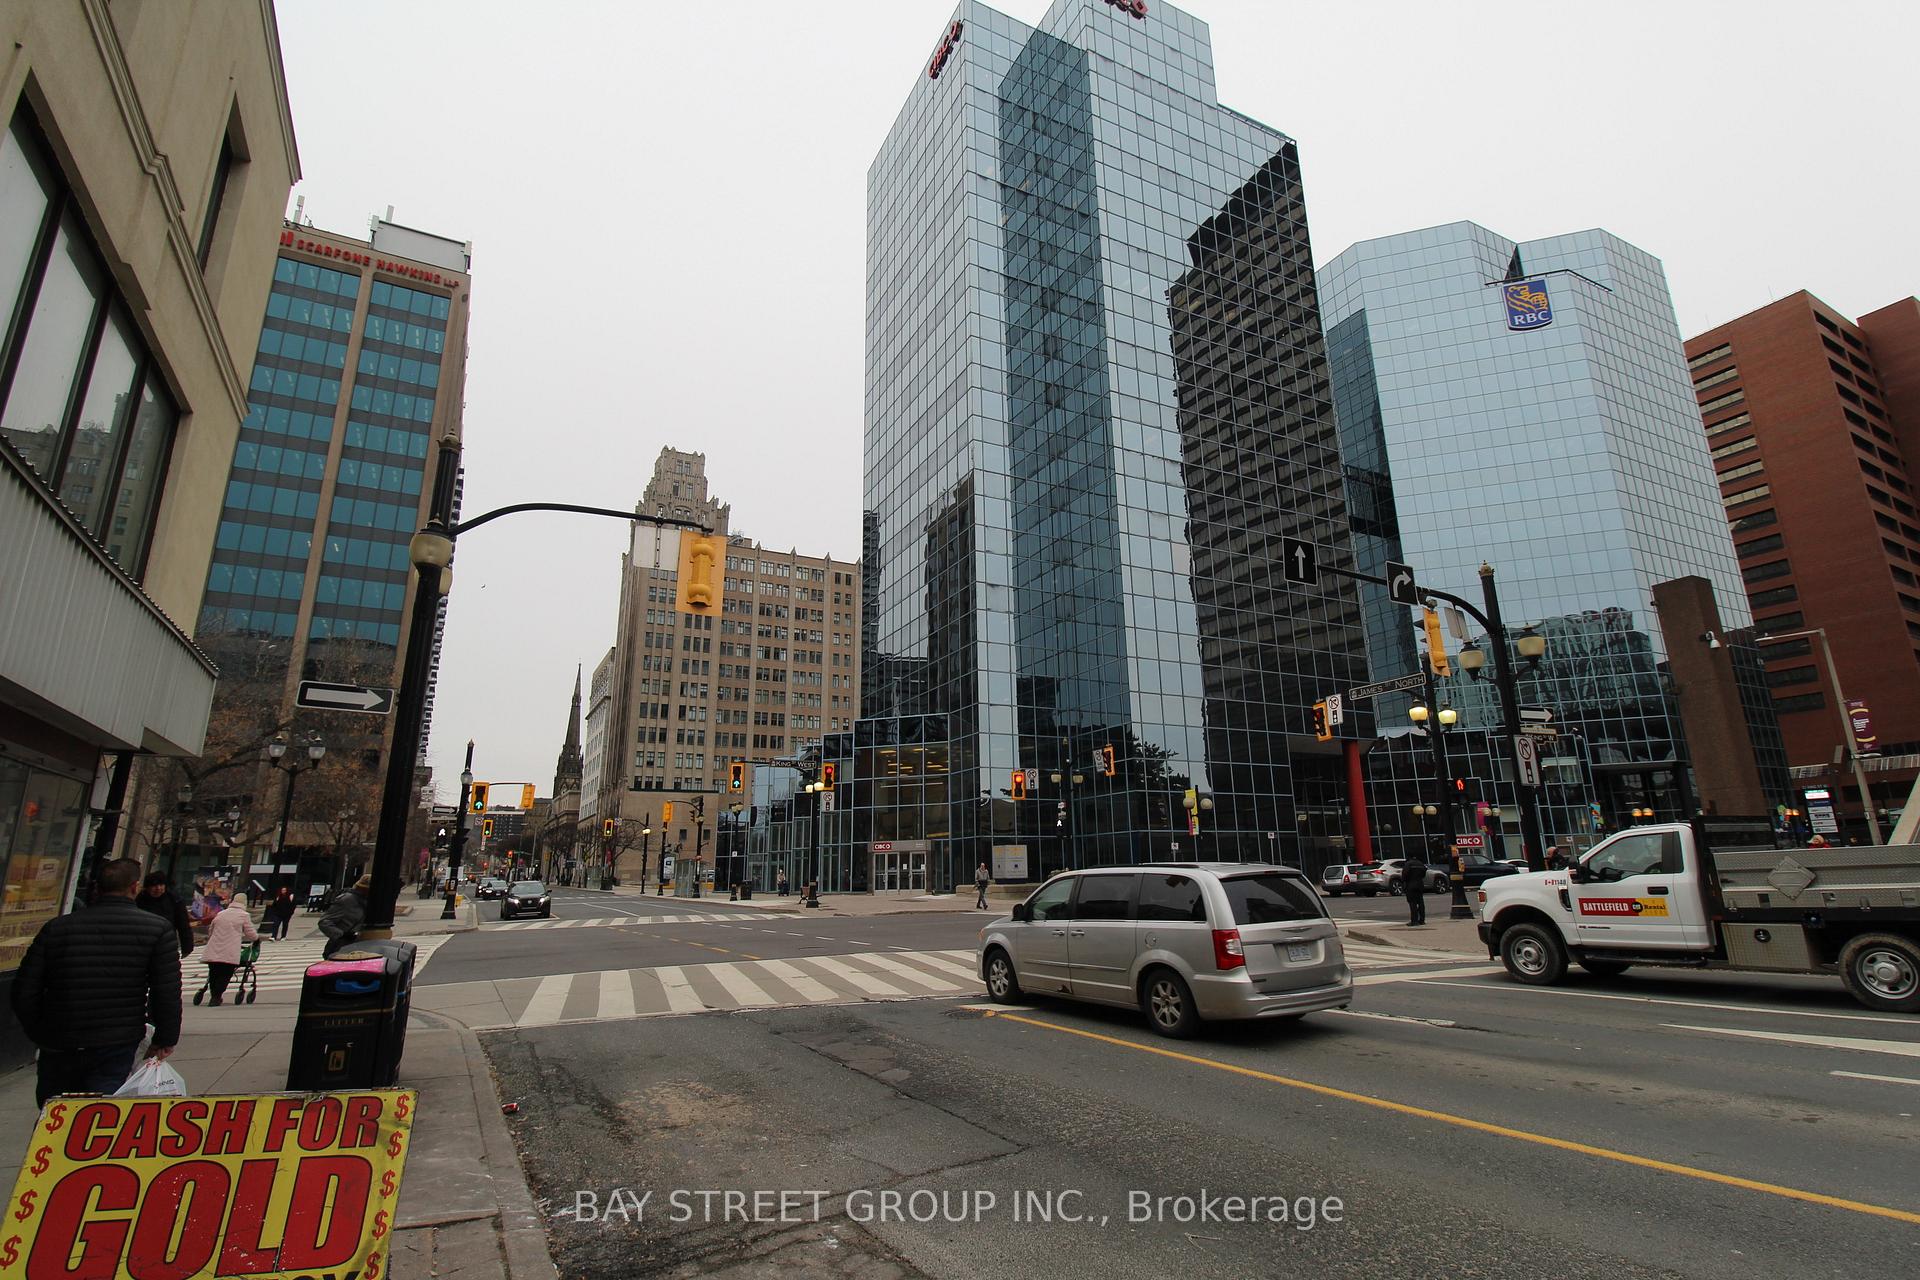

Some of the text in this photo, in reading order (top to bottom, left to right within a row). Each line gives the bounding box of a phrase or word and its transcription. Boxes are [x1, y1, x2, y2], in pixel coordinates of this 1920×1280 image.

[296, 239, 371, 267] SCARFONE
[376, 259, 442, 285] HAWKINS
[1513, 311, 1550, 325] RBC
[1358, 685, 1383, 697] JAMES
[1394, 677, 1424, 689] NORTH
[797, 760, 815, 768] WEST
[1582, 902, 1630, 912] BATTLEFIELD
[324, 1018, 366, 1026] LITTER
[64, 1095, 384, 1161] CASH FOR
[25, 1154, 373, 1280] GOLD
